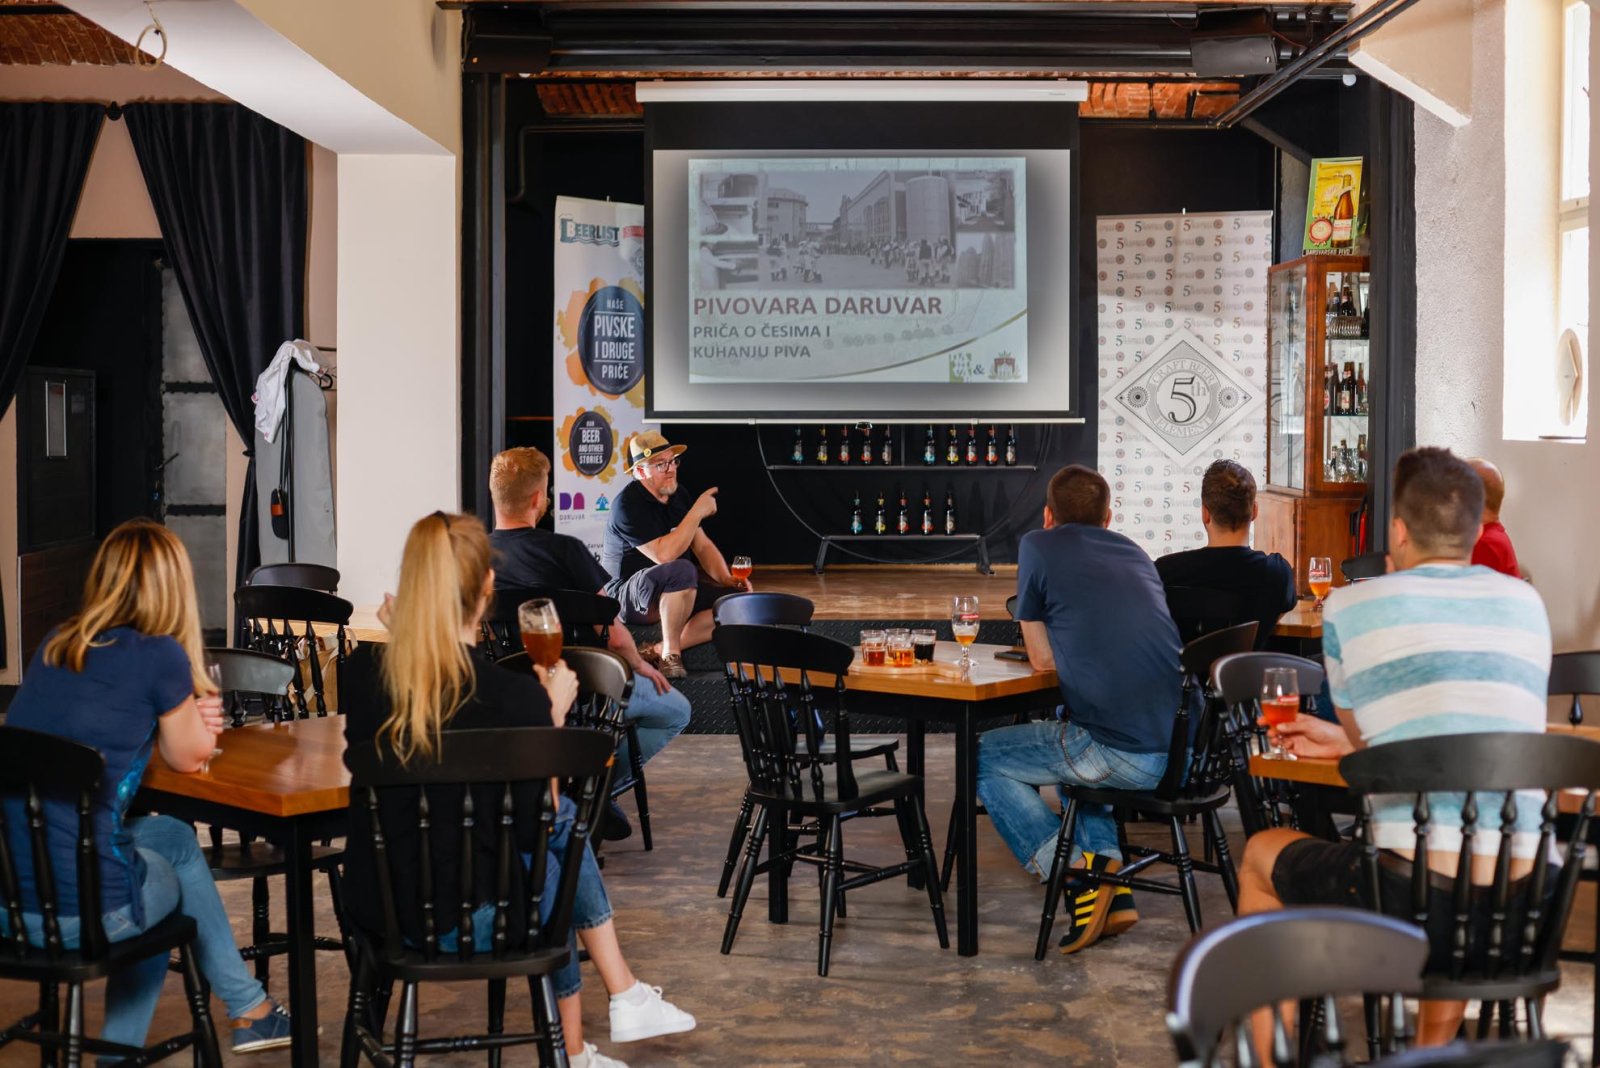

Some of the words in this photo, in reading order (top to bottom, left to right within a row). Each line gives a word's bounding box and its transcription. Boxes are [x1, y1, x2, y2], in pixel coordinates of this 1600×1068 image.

[607, 298, 624, 310] NAŠE
[693, 297, 817, 315] PIVOVARA
[825, 296, 942, 315] DARUVAR
[594, 315, 635, 338] PIVSKE
[693, 323, 740, 339] PRIČA
[744, 326, 757, 338] O
[761, 321, 821, 339] ČESIMA
[602, 341, 635, 360] DRUGE
[693, 346, 769, 360] KUHANJU
[774, 345, 811, 359] PIVA
[602, 363, 629, 379] PRIČE
[1152, 360, 1187, 384] CRAFT
[1189, 361, 1215, 384] BEER
[1154, 416, 1211, 437] ELEMENT
[582, 430, 600, 443] BEER
[579, 444, 588, 452] AND
[588, 444, 604, 452] OTHER
[579, 456, 603, 464] STORIES
